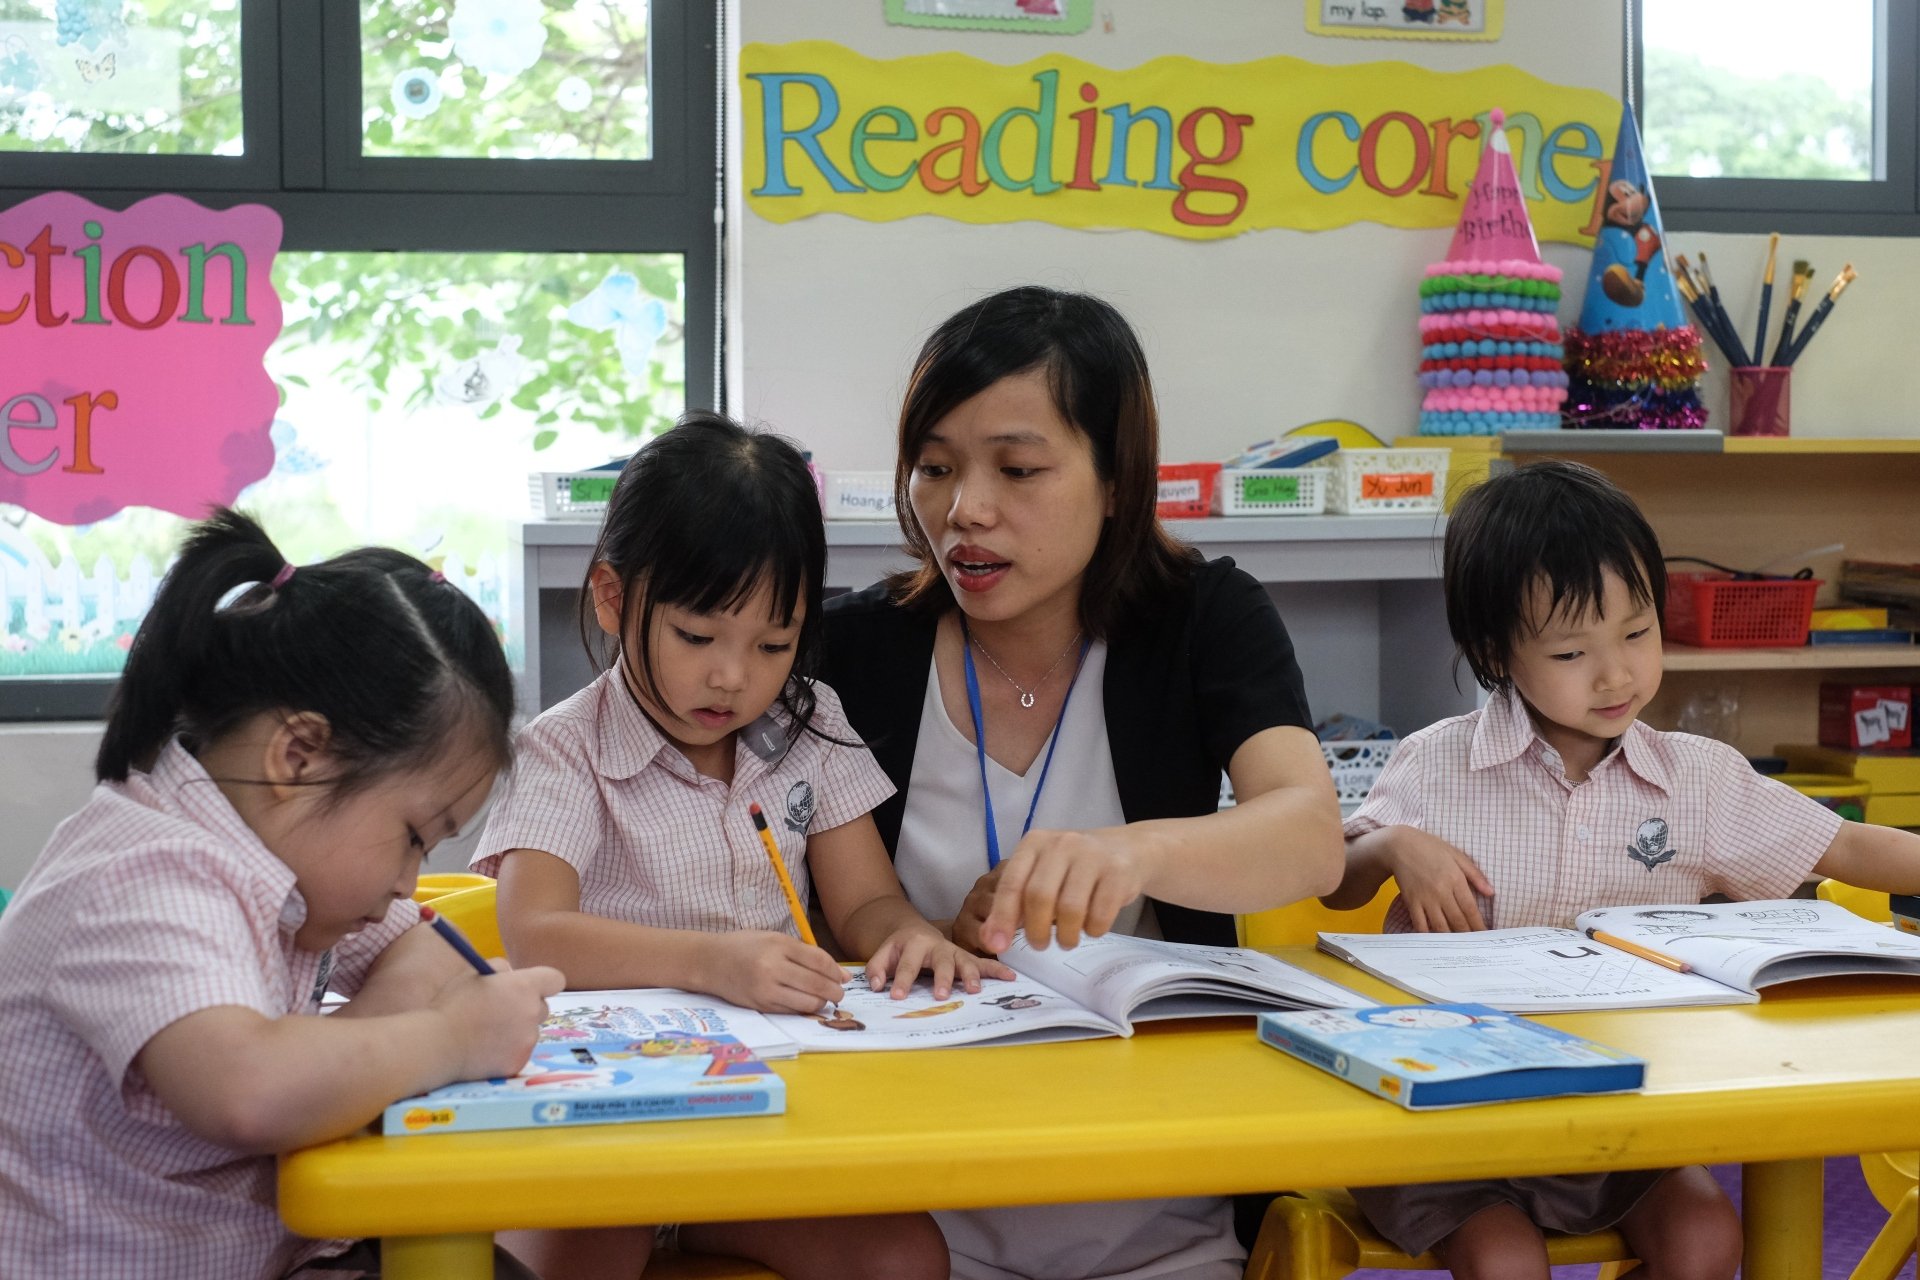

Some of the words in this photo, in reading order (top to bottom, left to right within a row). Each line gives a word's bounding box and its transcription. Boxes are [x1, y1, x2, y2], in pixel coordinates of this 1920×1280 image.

[1330, 5, 1355, 20] my
[1361, 5, 1387, 21] lap.
[746, 69, 1254, 227] Reading
[1157, 484, 1196, 499] guyen
[840, 492, 884, 511] Hoang
